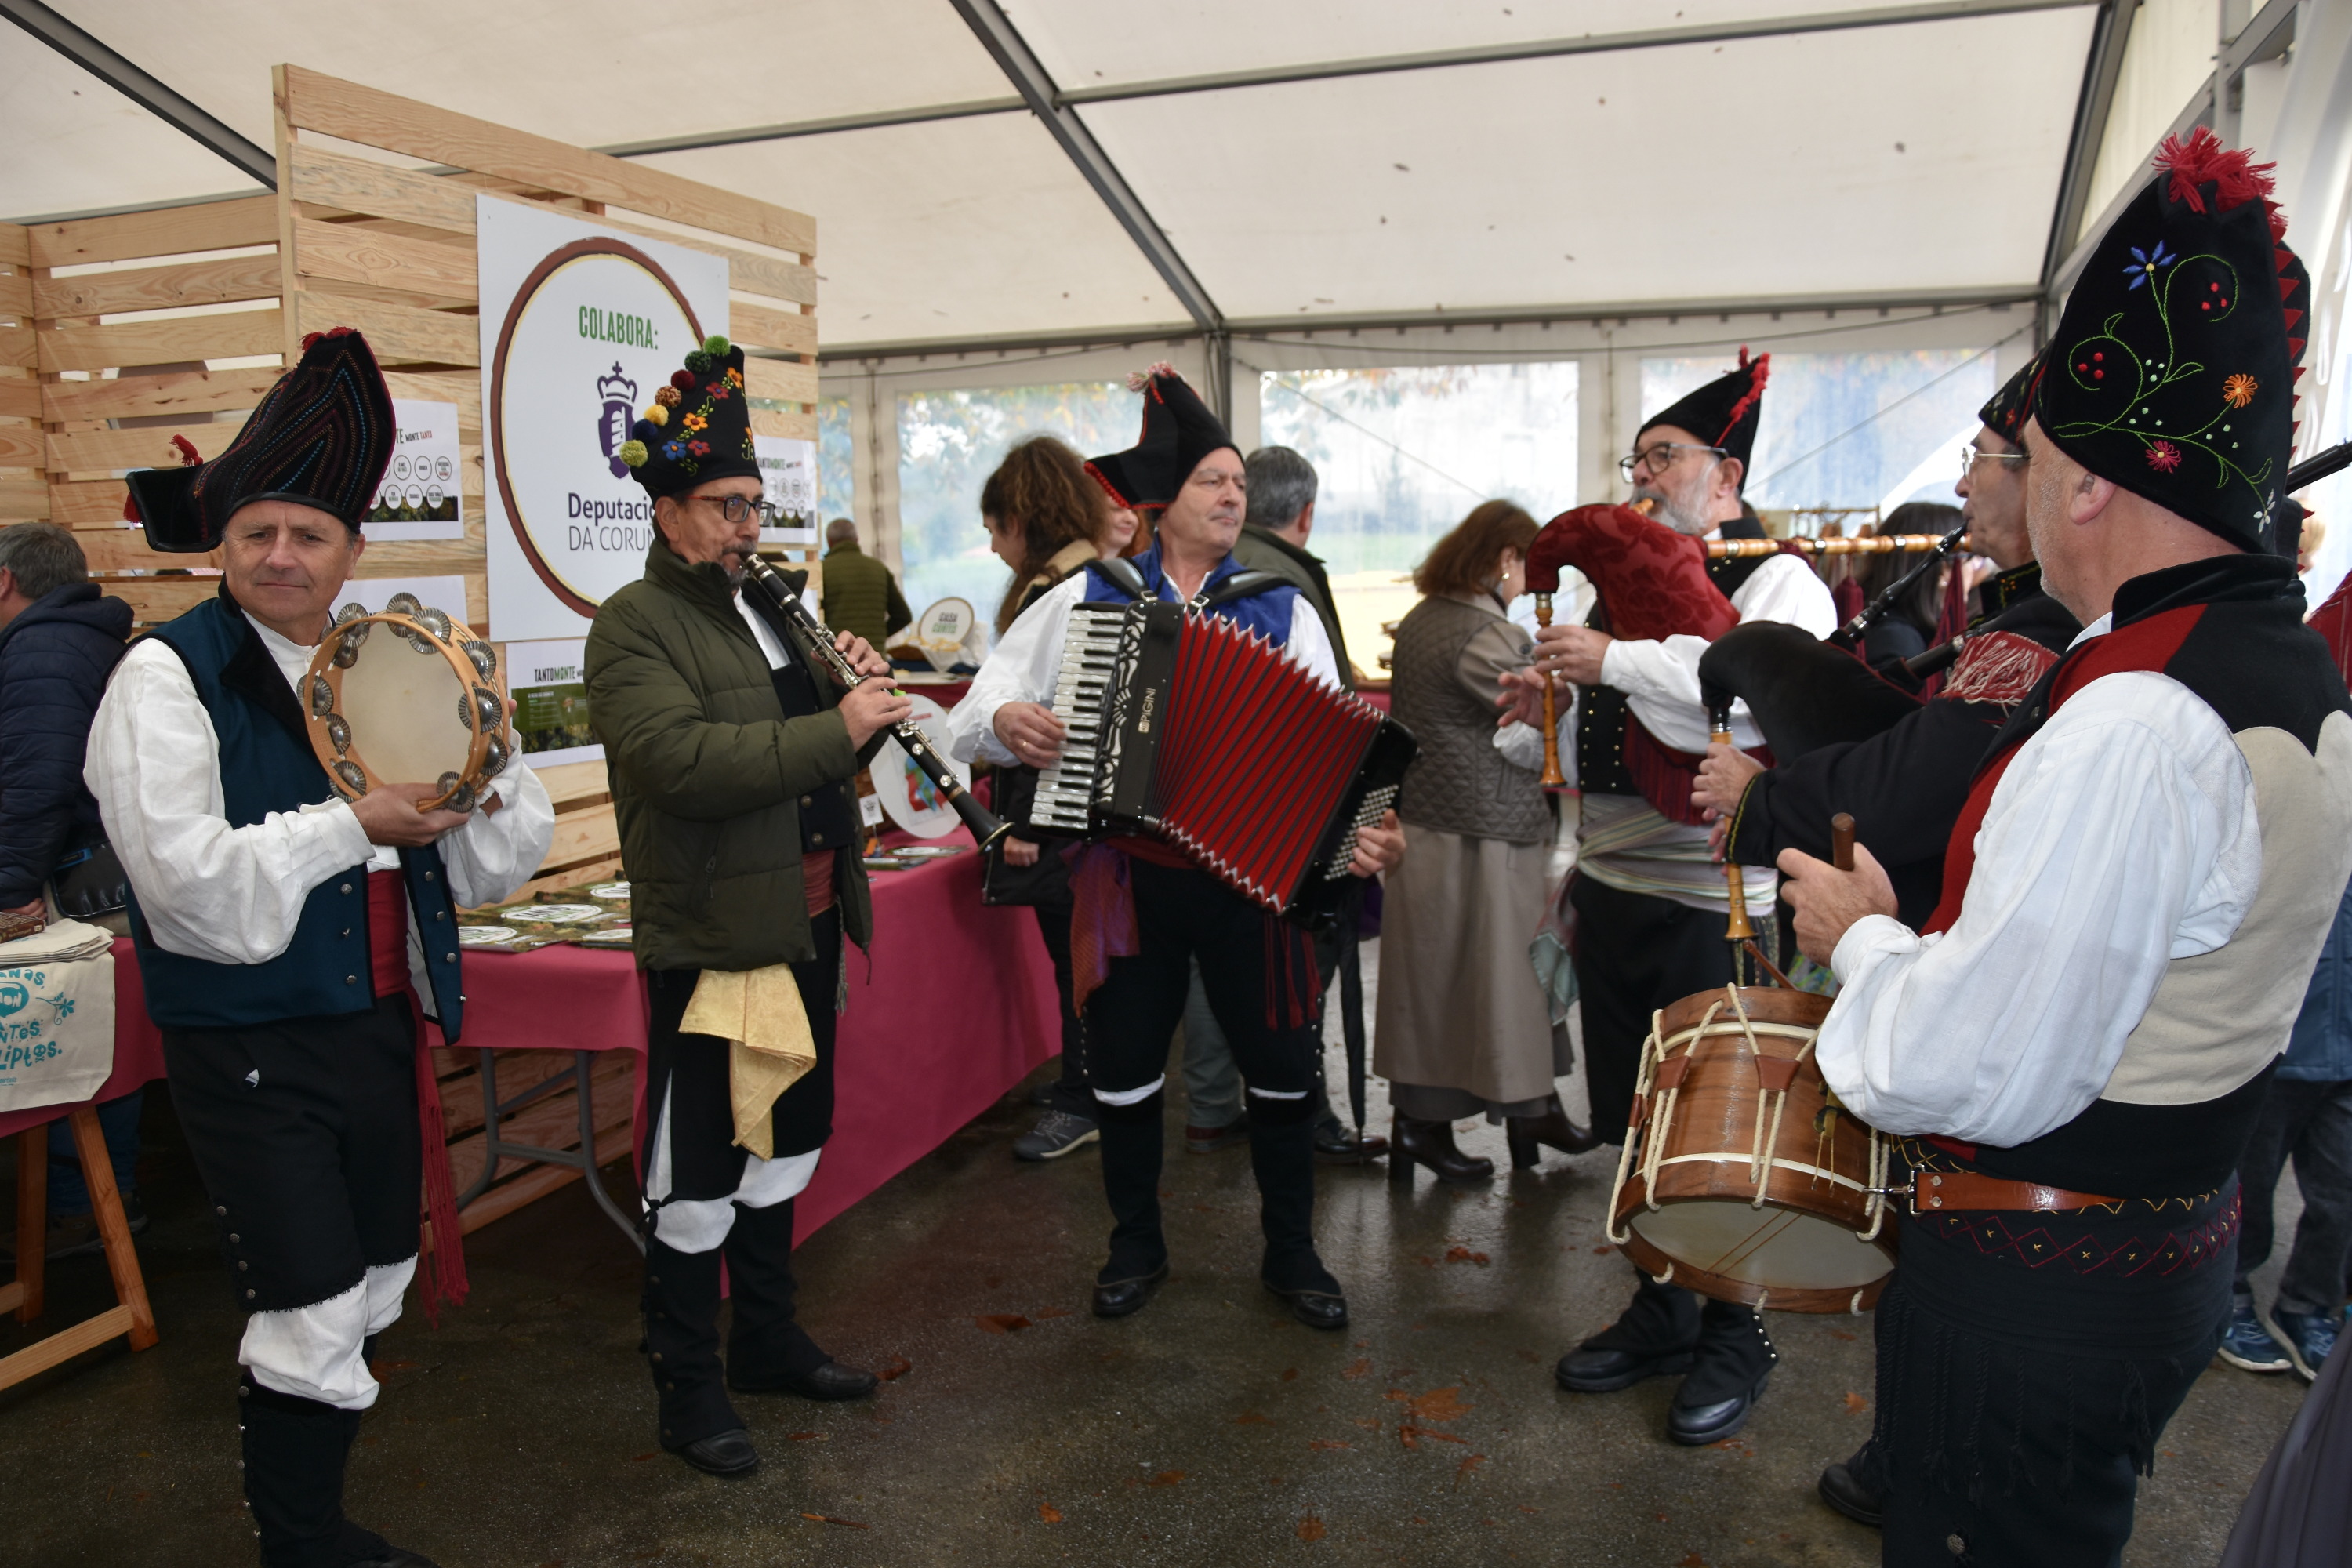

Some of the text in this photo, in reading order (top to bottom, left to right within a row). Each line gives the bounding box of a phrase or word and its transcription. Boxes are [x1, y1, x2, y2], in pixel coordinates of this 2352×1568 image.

[579, 305, 658, 350] COLABORA:
[569, 526, 593, 550] DA
[535, 666, 576, 682] TANTOMONTE
[1141, 688, 1156, 722] PIGINI
